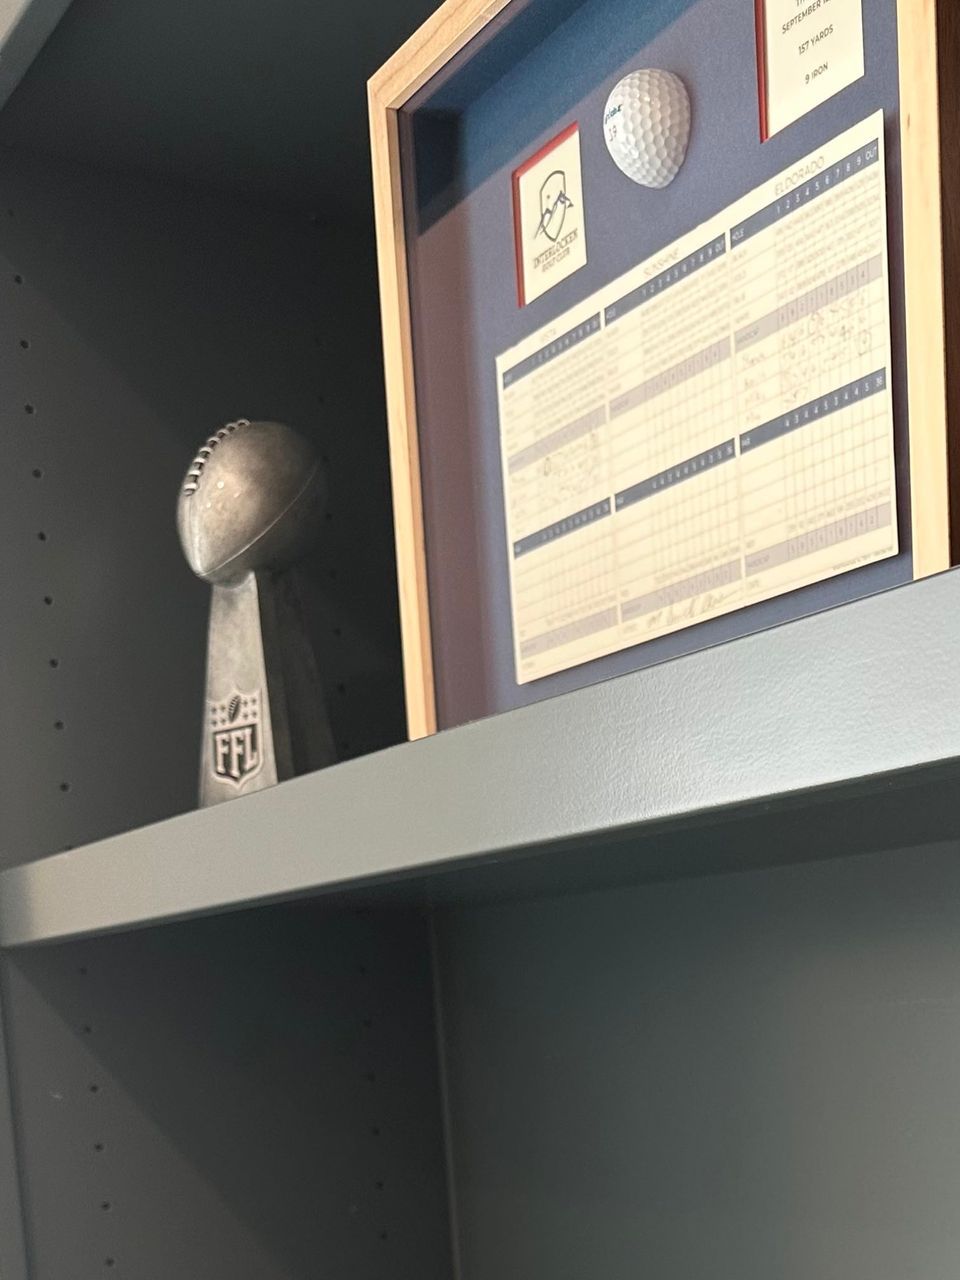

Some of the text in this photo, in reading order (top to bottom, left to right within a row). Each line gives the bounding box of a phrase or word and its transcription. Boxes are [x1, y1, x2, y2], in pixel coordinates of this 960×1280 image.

[782, 0, 821, 34] SEPTEMBER
[798, 24, 834, 55] 157 YARDS
[805, 62, 829, 84] 9 IRON
[774, 156, 825, 196] ELDORADO
[215, 726, 258, 778] FFL
